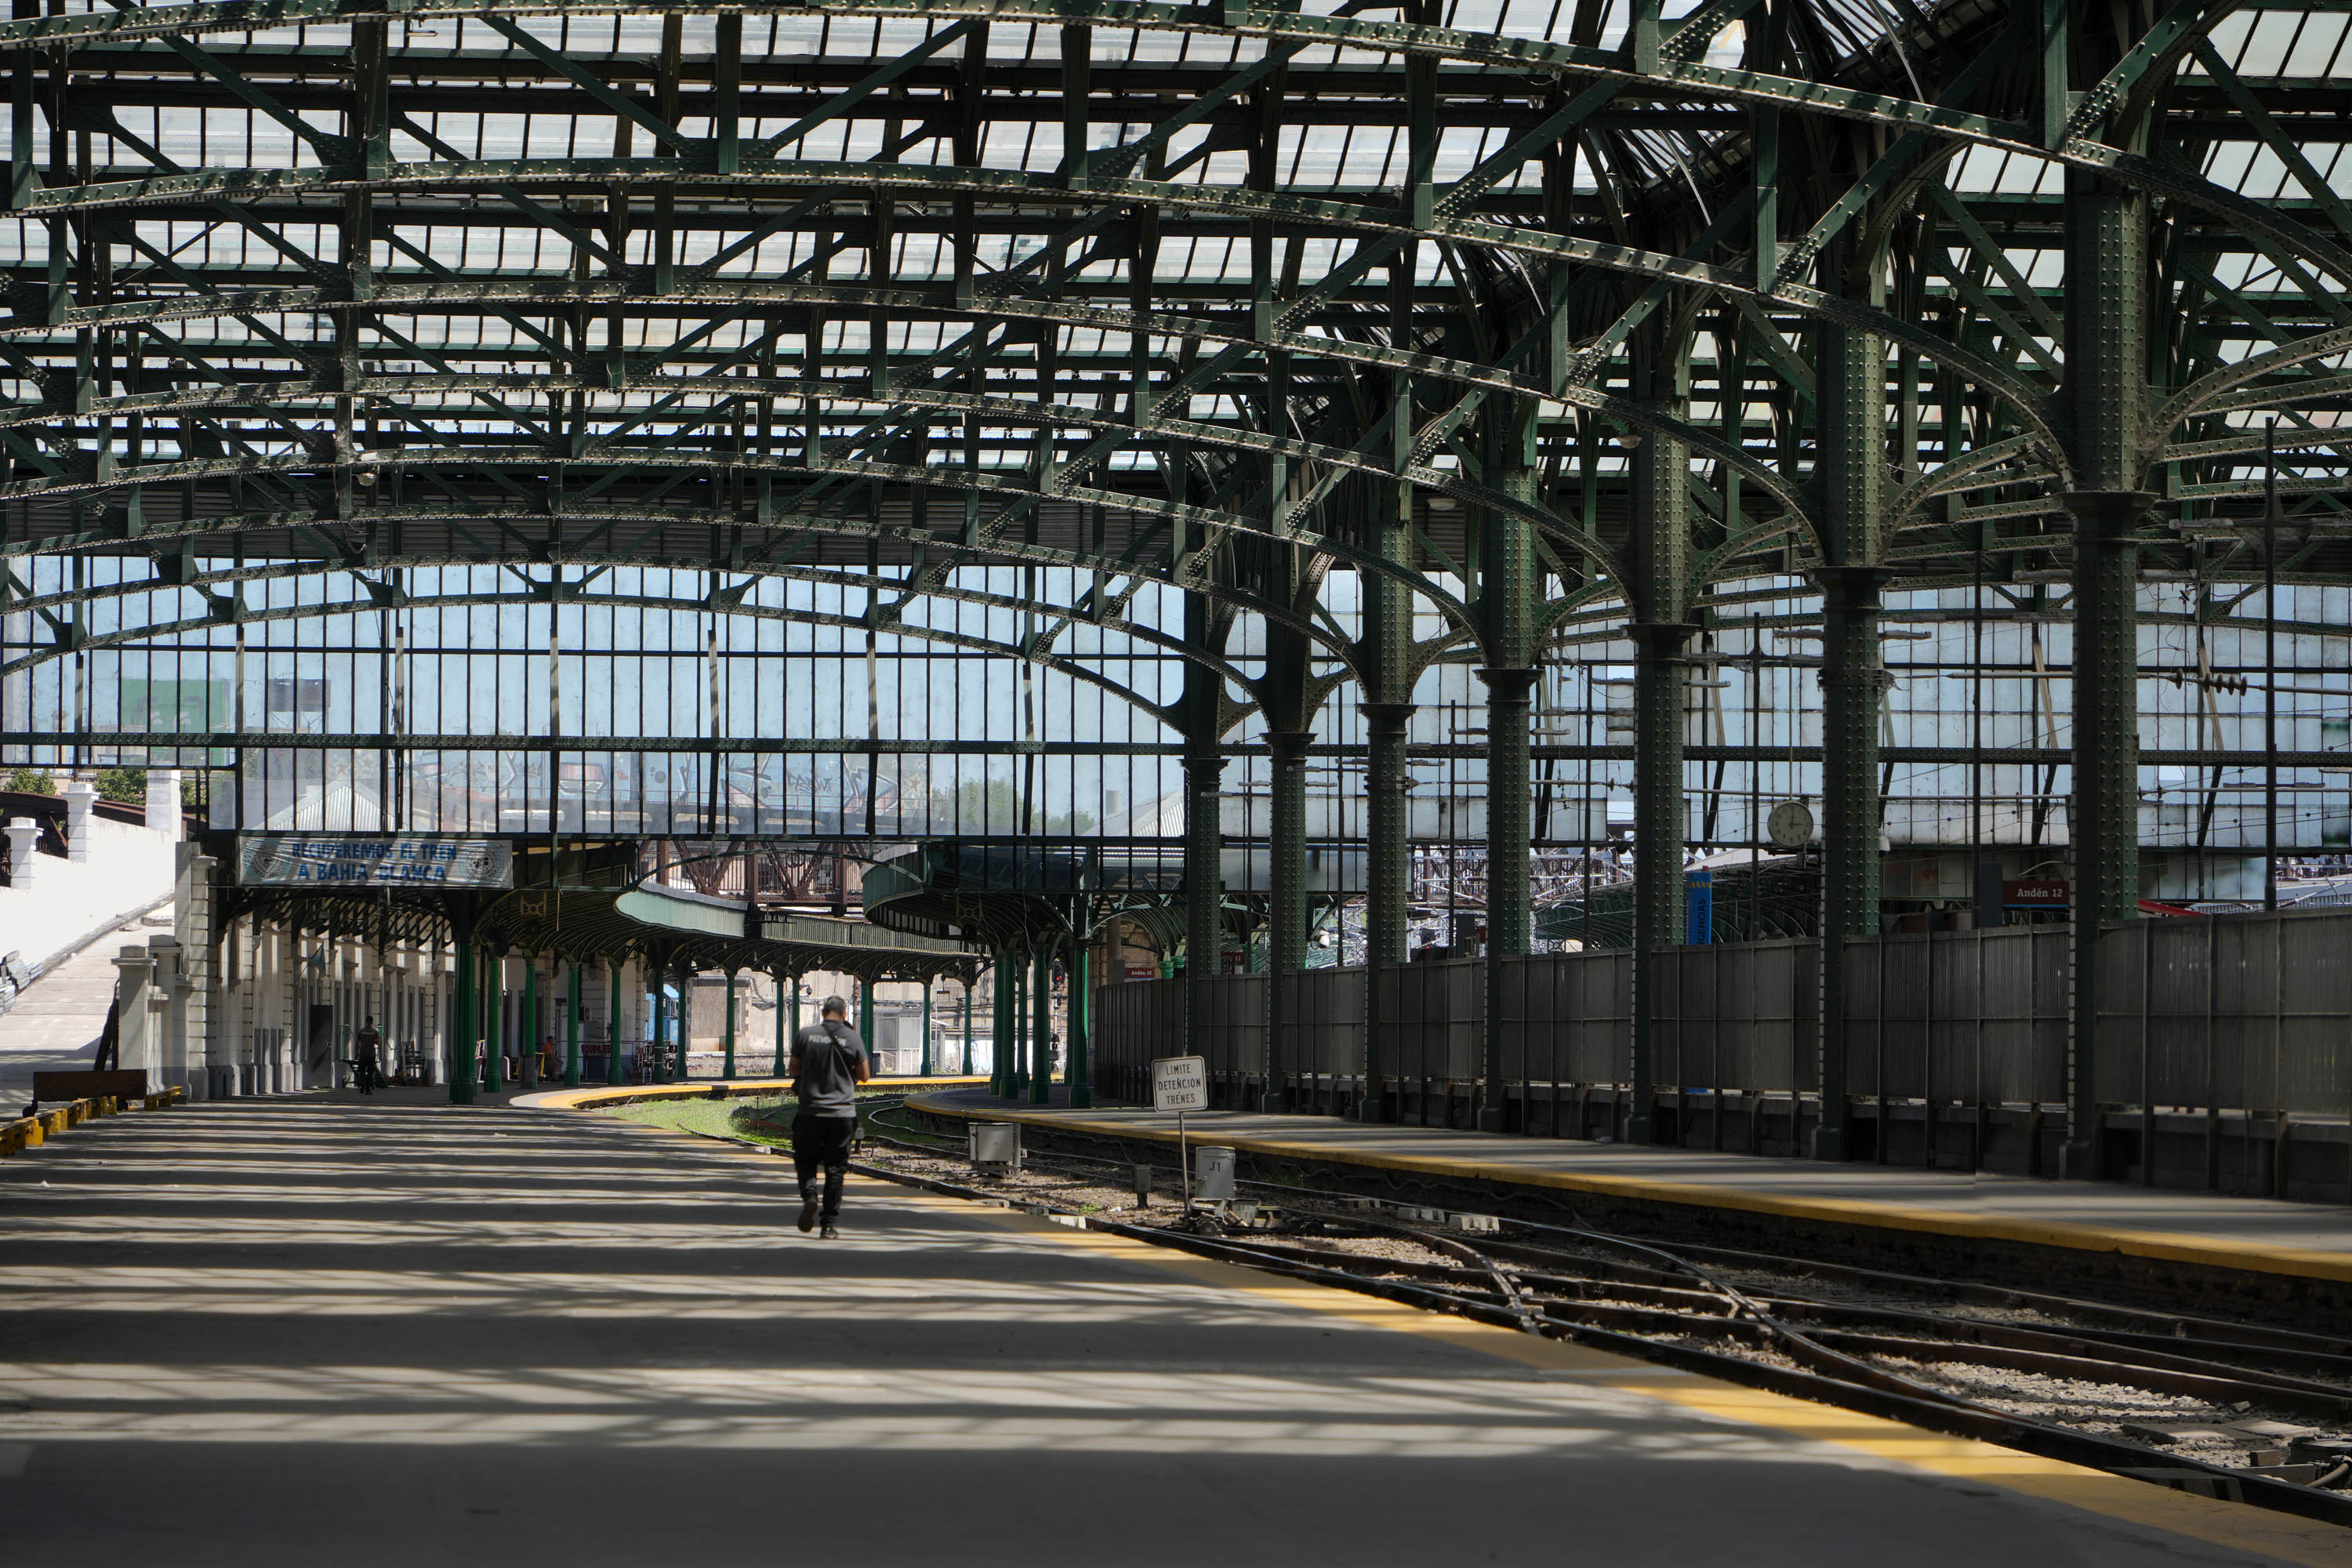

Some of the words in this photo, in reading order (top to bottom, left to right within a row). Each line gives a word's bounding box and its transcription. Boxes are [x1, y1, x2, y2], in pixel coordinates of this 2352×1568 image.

[292, 843, 394, 859] RECUPEREMOS
[400, 844, 416, 860] EL
[420, 844, 456, 861] TREN
[298, 862, 310, 880] A
[317, 863, 368, 880] BAHIA
[379, 864, 447, 881] BLANCA
[2017, 887, 2049, 898] Andén
[2052, 887, 2063, 898] 12
[1166, 1064, 1192, 1076] LIMITE
[1158, 1078, 1201, 1091] DETENCION
[1167, 1094, 1196, 1105] TRENES
[1208, 1161, 1221, 1173] J1
